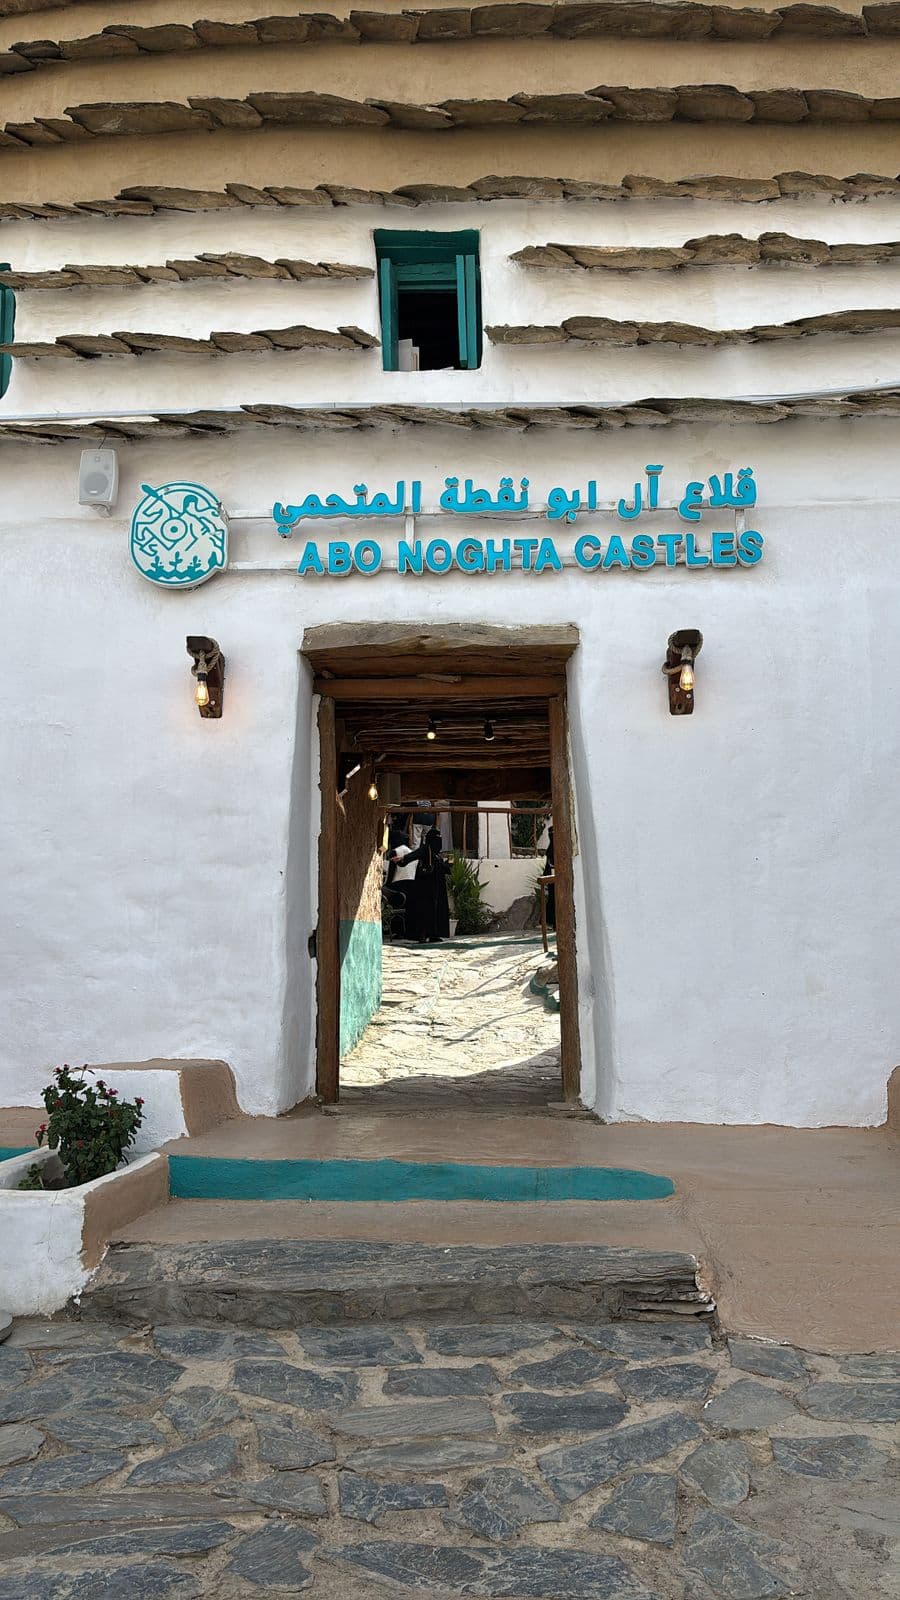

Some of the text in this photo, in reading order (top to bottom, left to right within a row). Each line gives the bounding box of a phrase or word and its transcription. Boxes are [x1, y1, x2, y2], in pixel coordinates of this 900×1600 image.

[272, 464, 758, 538] قلاع آل ابو نقطة المتحمي
[297, 530, 765, 575] ABO NOGHTA CASTLES
